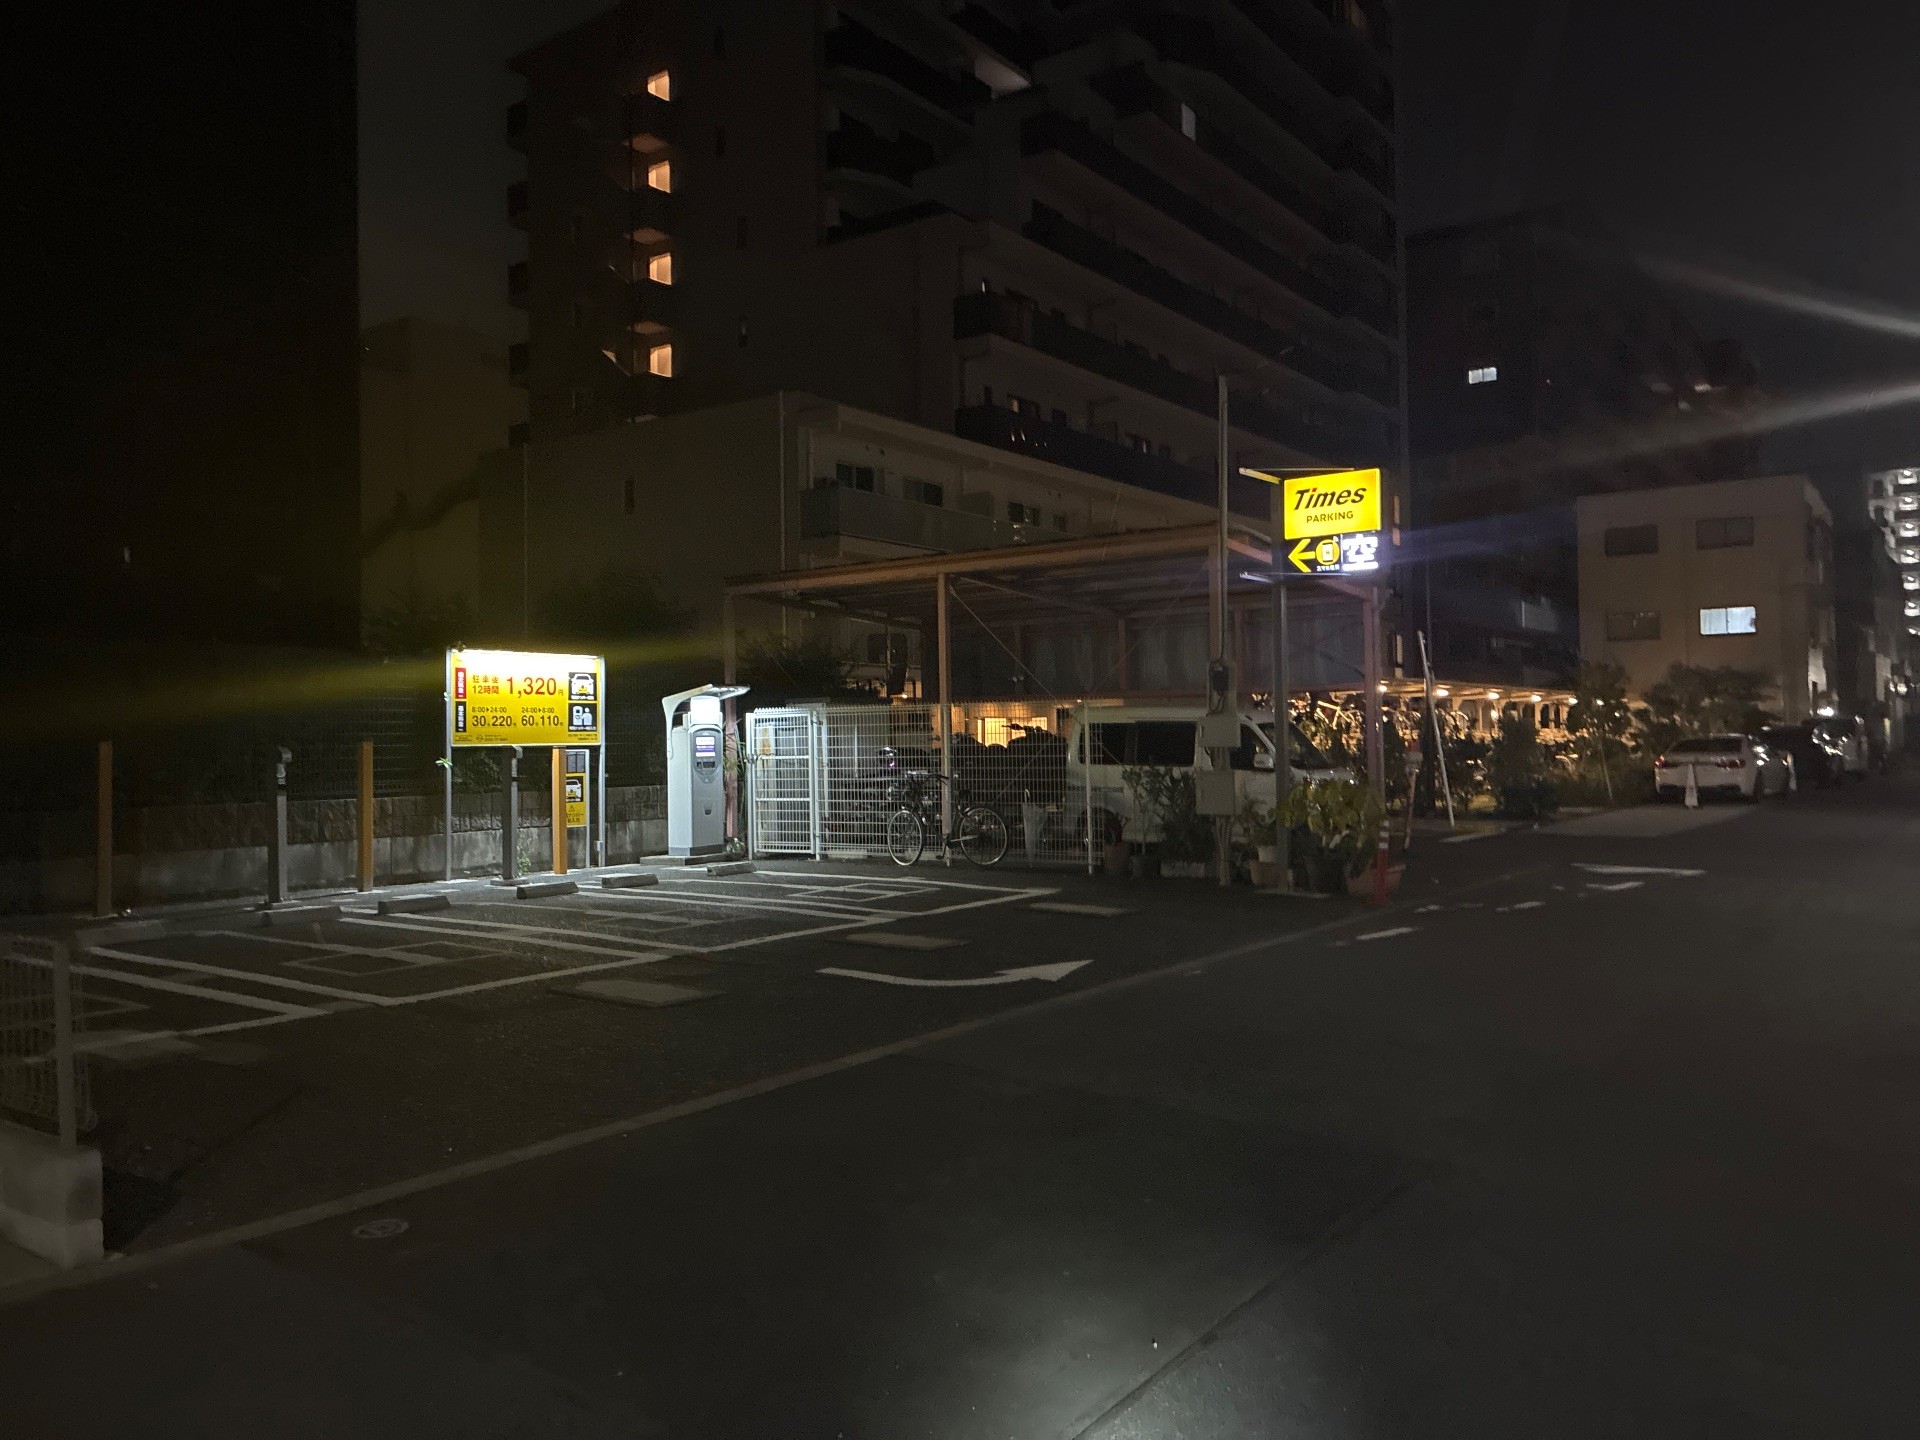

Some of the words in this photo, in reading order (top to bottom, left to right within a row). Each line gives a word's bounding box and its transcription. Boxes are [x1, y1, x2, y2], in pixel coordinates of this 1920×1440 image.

[1294, 487, 1367, 511] Times
[1306, 510, 1354, 524] PARKING
[472, 685, 499, 695] 12時間
